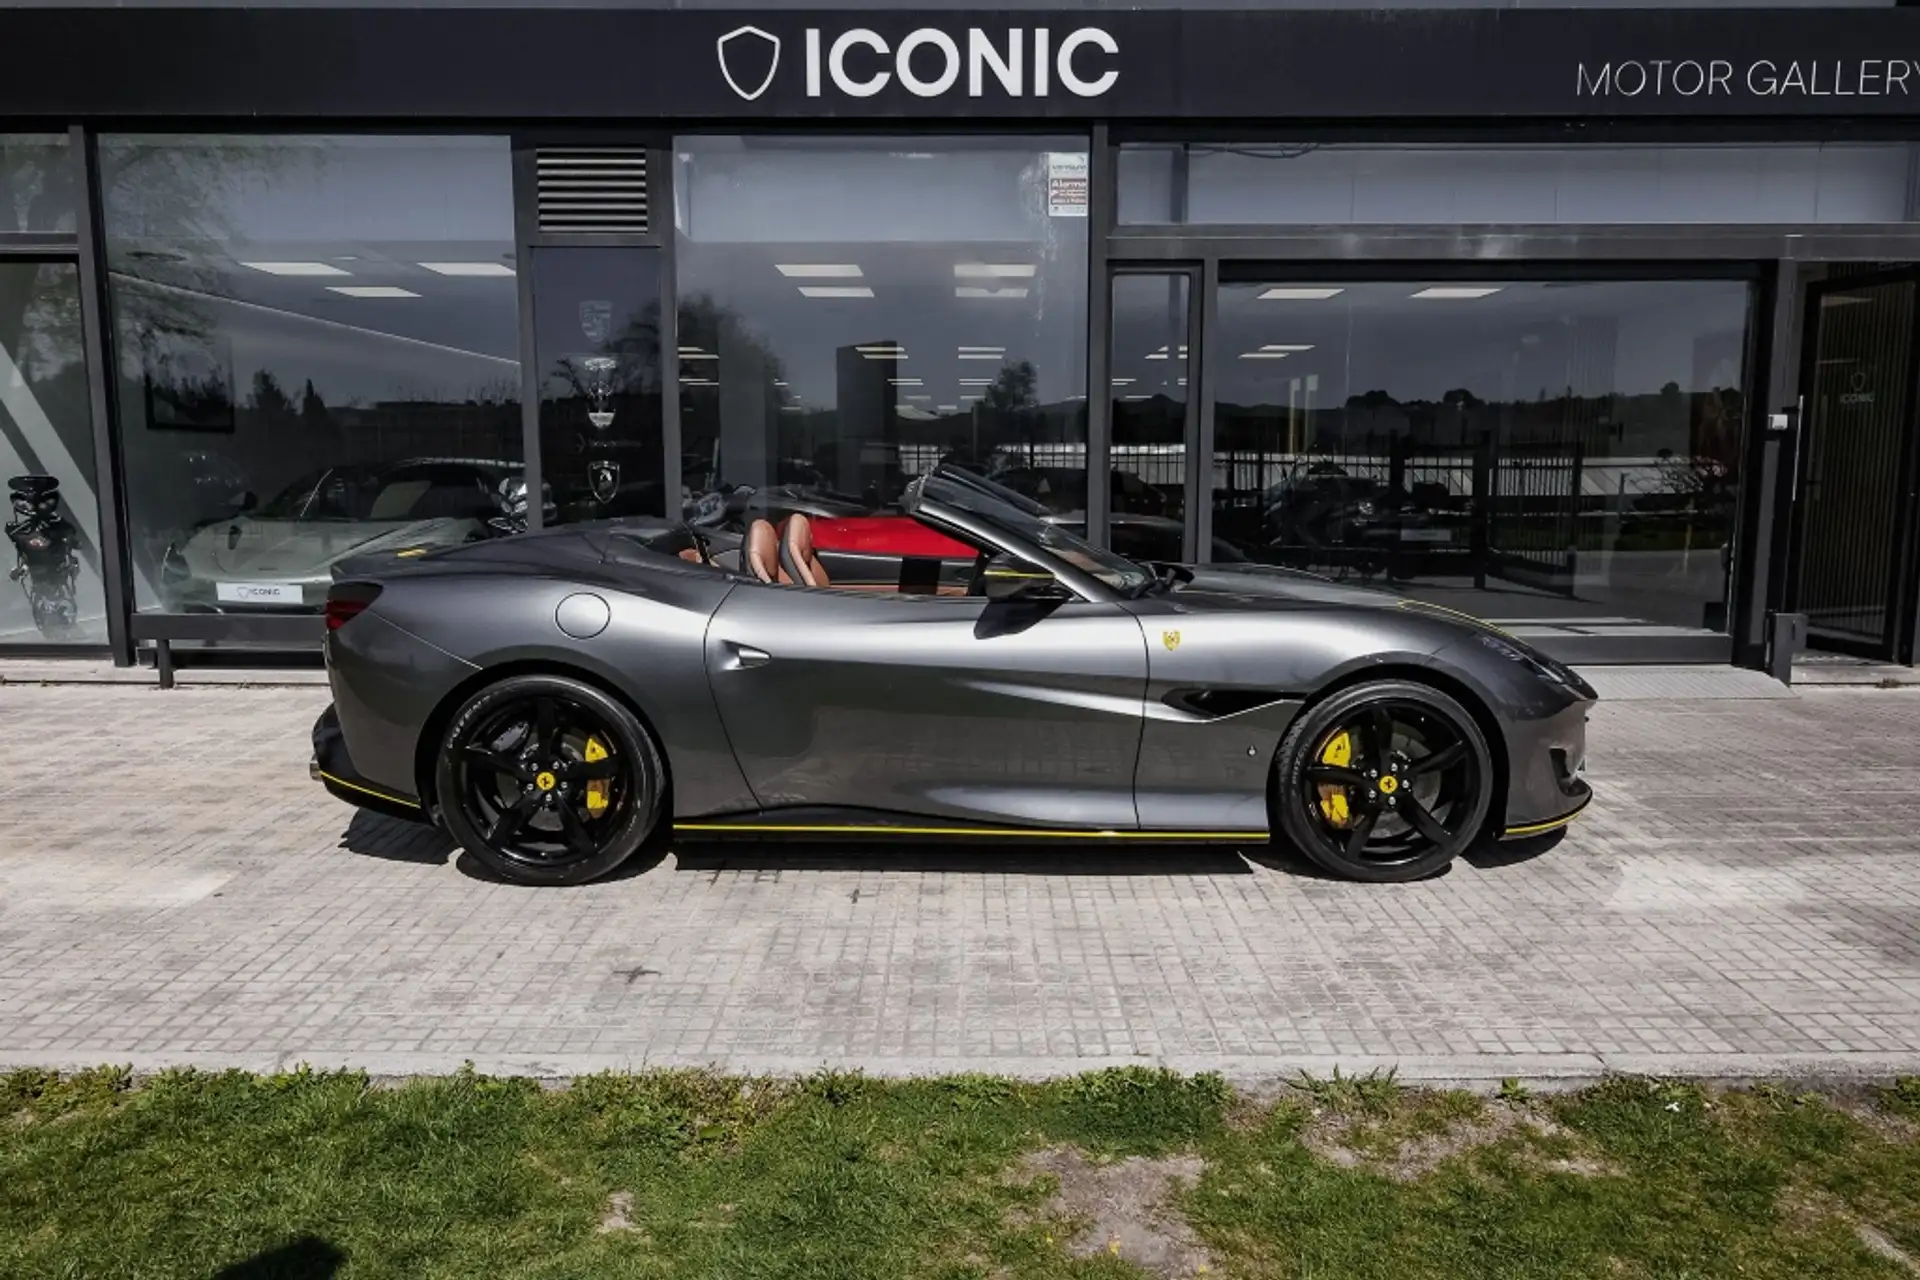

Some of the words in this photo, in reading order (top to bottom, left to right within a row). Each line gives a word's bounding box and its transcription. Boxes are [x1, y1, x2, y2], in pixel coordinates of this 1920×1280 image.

[805, 27, 1120, 97] ICONIC
[1576, 60, 1733, 96] MOTOR
[1746, 60, 1920, 95] GALLER
